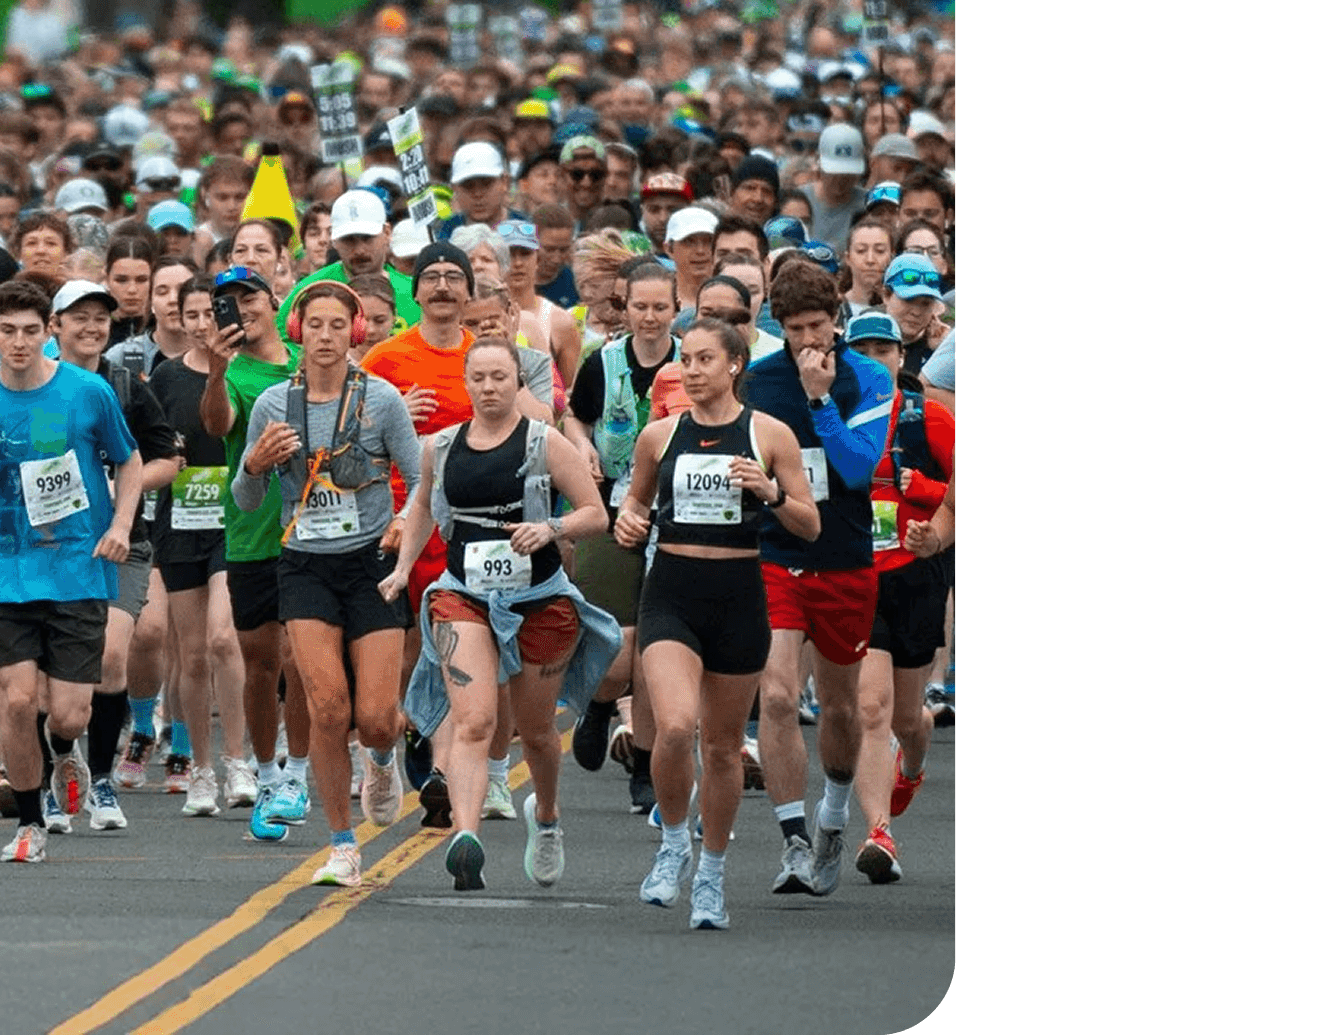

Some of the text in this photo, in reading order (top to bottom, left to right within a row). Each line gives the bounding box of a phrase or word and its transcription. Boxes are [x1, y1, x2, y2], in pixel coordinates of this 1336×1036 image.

[319, 93, 352, 112] 5:05
[36, 471, 71, 493] 9399
[686, 473, 731, 492] 12094
[185, 484, 220, 501] 7259
[484, 559, 513, 577] 993
